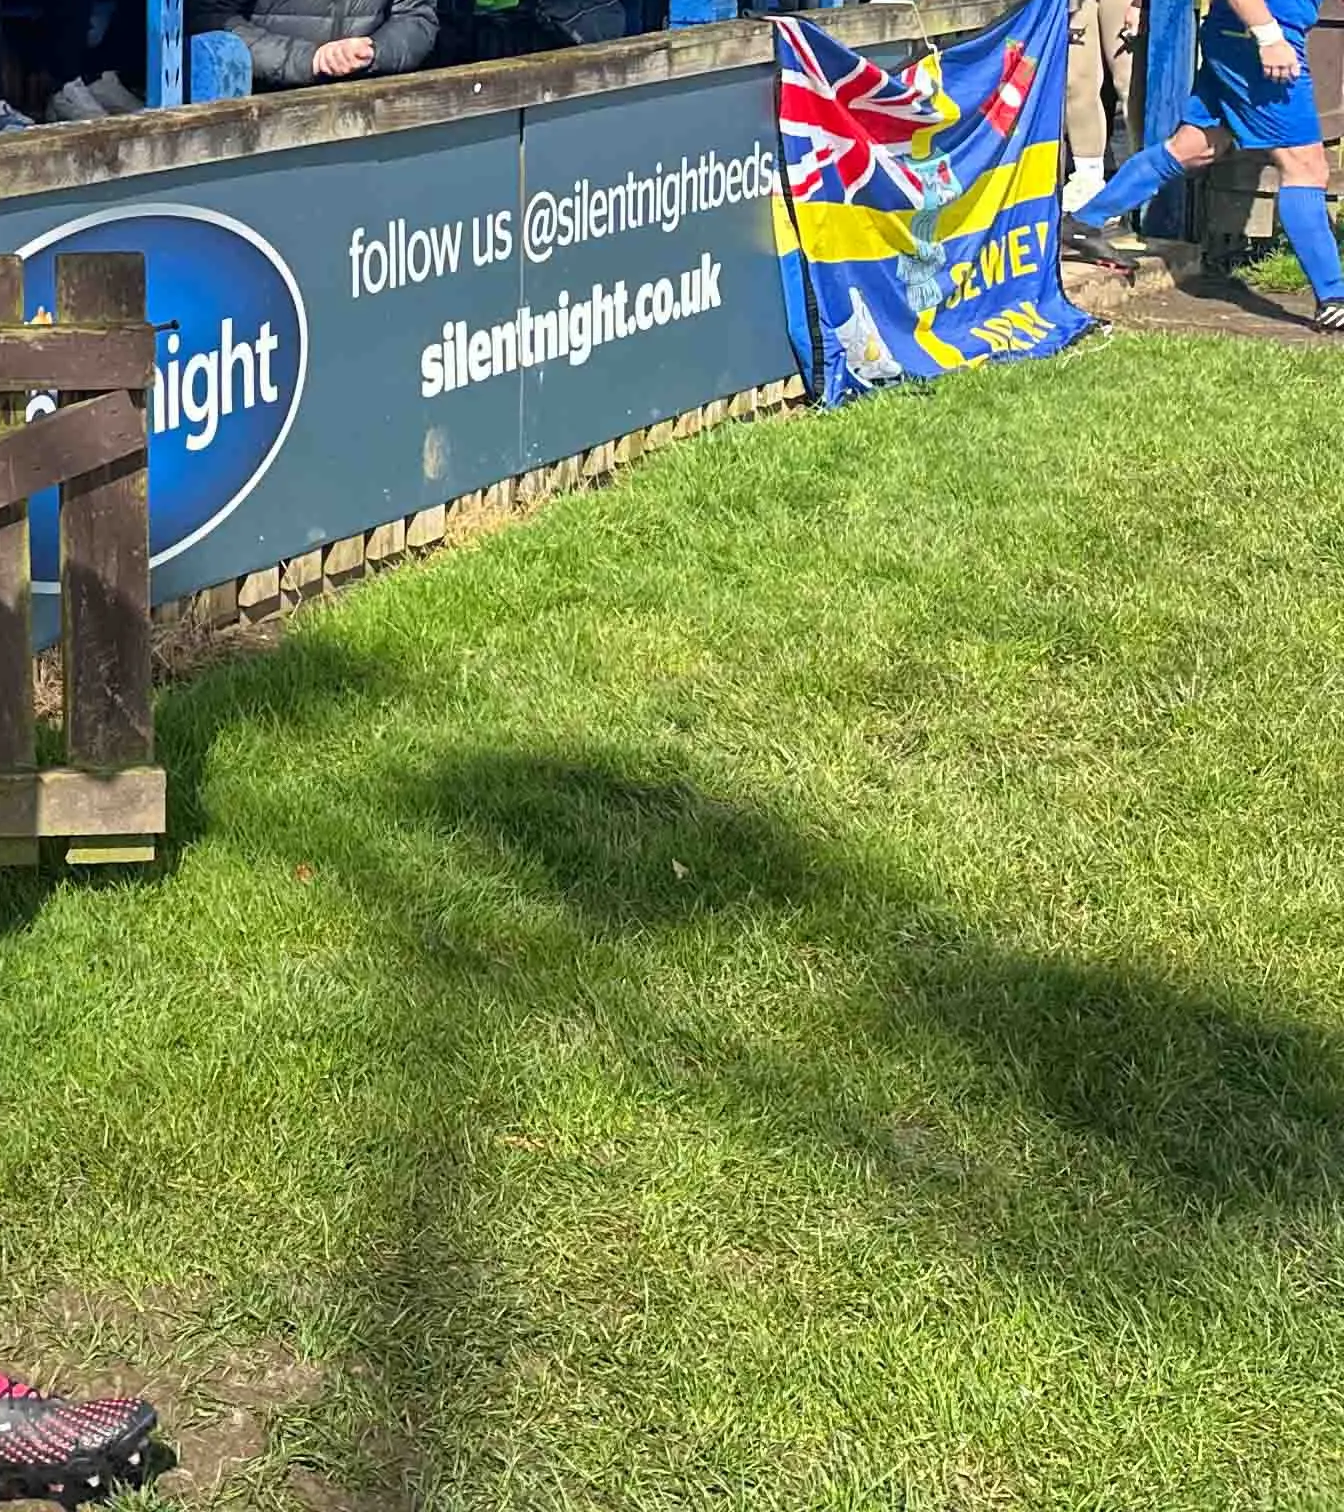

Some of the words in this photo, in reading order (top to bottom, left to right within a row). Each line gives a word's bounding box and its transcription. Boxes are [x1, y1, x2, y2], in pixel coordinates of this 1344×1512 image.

[349, 212, 462, 299] follow
[471, 205, 511, 263] us
[522, 140, 773, 263] @silentnightbeds
[420, 253, 721, 398] silentnight.co.uk
